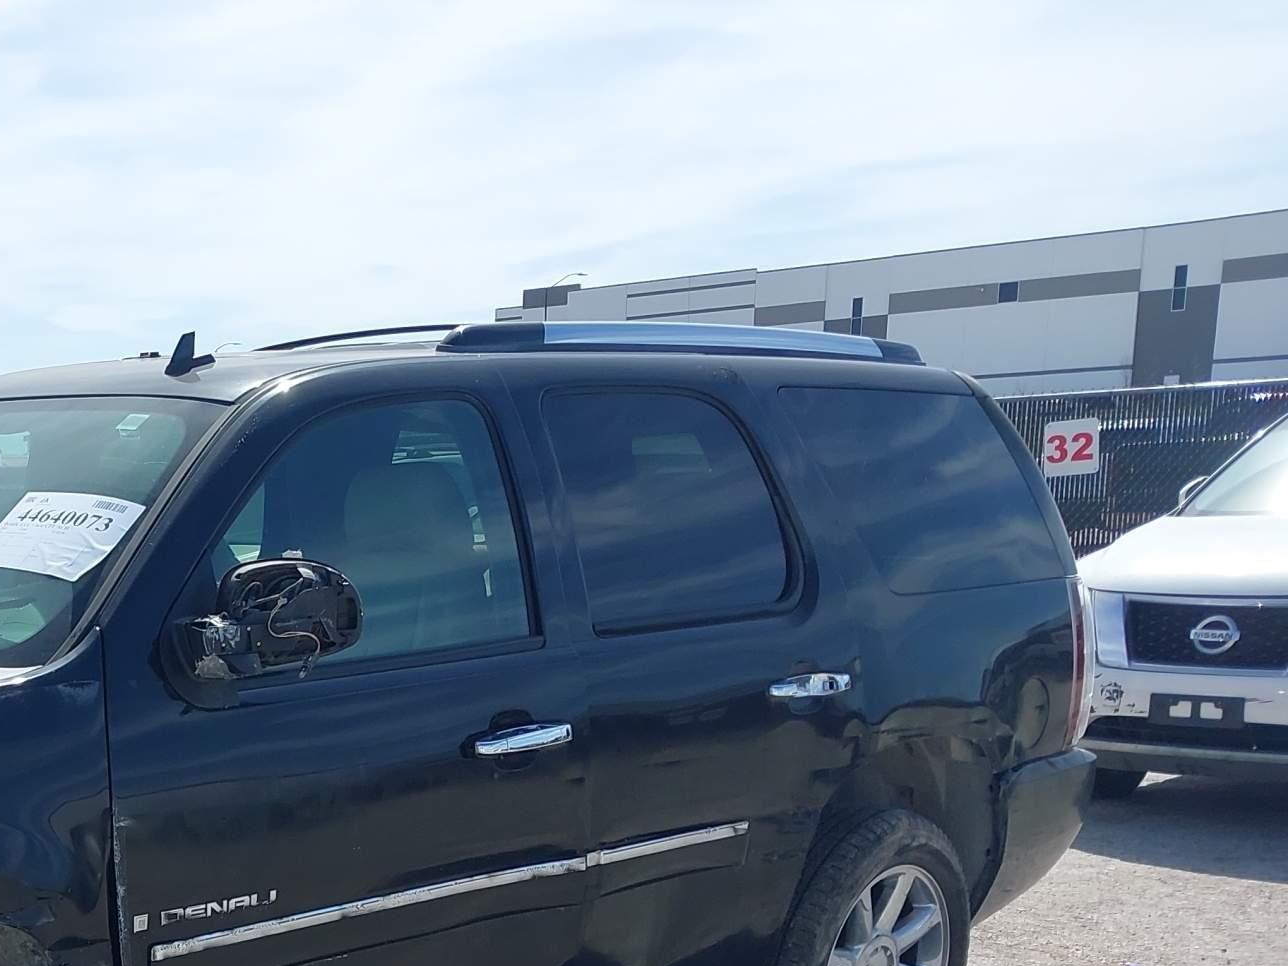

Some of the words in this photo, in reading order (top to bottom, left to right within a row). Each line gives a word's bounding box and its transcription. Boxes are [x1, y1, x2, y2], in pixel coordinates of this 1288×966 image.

[1046, 432, 1094, 464] 32
[16, 508, 116, 532] 44640073
[1193, 631, 1233, 640] NISSAN
[160, 889, 278, 926] DENALI
